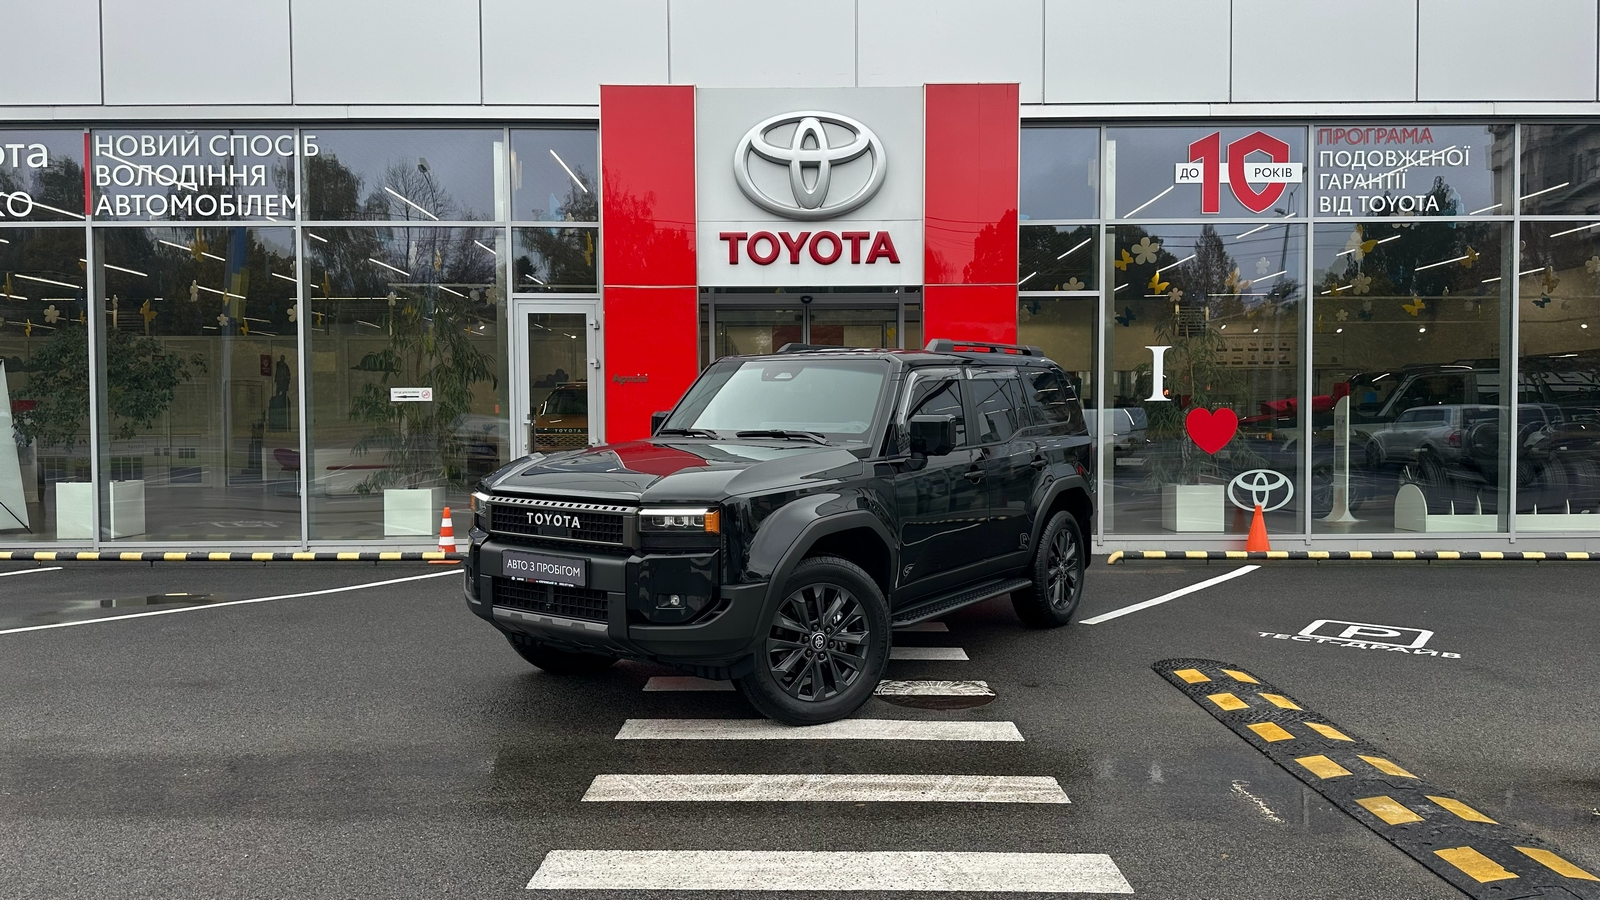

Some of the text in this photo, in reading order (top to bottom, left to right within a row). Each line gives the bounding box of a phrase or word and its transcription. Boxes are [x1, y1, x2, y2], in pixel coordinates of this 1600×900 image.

[95, 129, 320, 157] НОВИЙ СПОСІБ
[1318, 127, 1434, 145] ПРОГРАМА
[0, 143, 49, 168] та
[1319, 146, 1470, 168] ПОДОВЖЕНОЇ
[95, 164, 267, 190] ВОЛОДІННЯ
[1179, 130, 1293, 214] ДО 10 РОКІВ
[1319, 168, 1407, 190] ГАРАНТІЇ
[94, 193, 301, 217] АВТОМОБІЛЕМ
[1319, 194, 1440, 216] ВІД TOYOTA
[718, 230, 901, 266] TOYOTA
[1144, 345, 1173, 402] I
[526, 512, 581, 529] TOYOTA
[506, 559, 528, 571] АВТО
[536, 562, 581, 577] ПРОБІГОМ
[1257, 631, 1462, 659] ТЕСТ-ДРАЙВ
